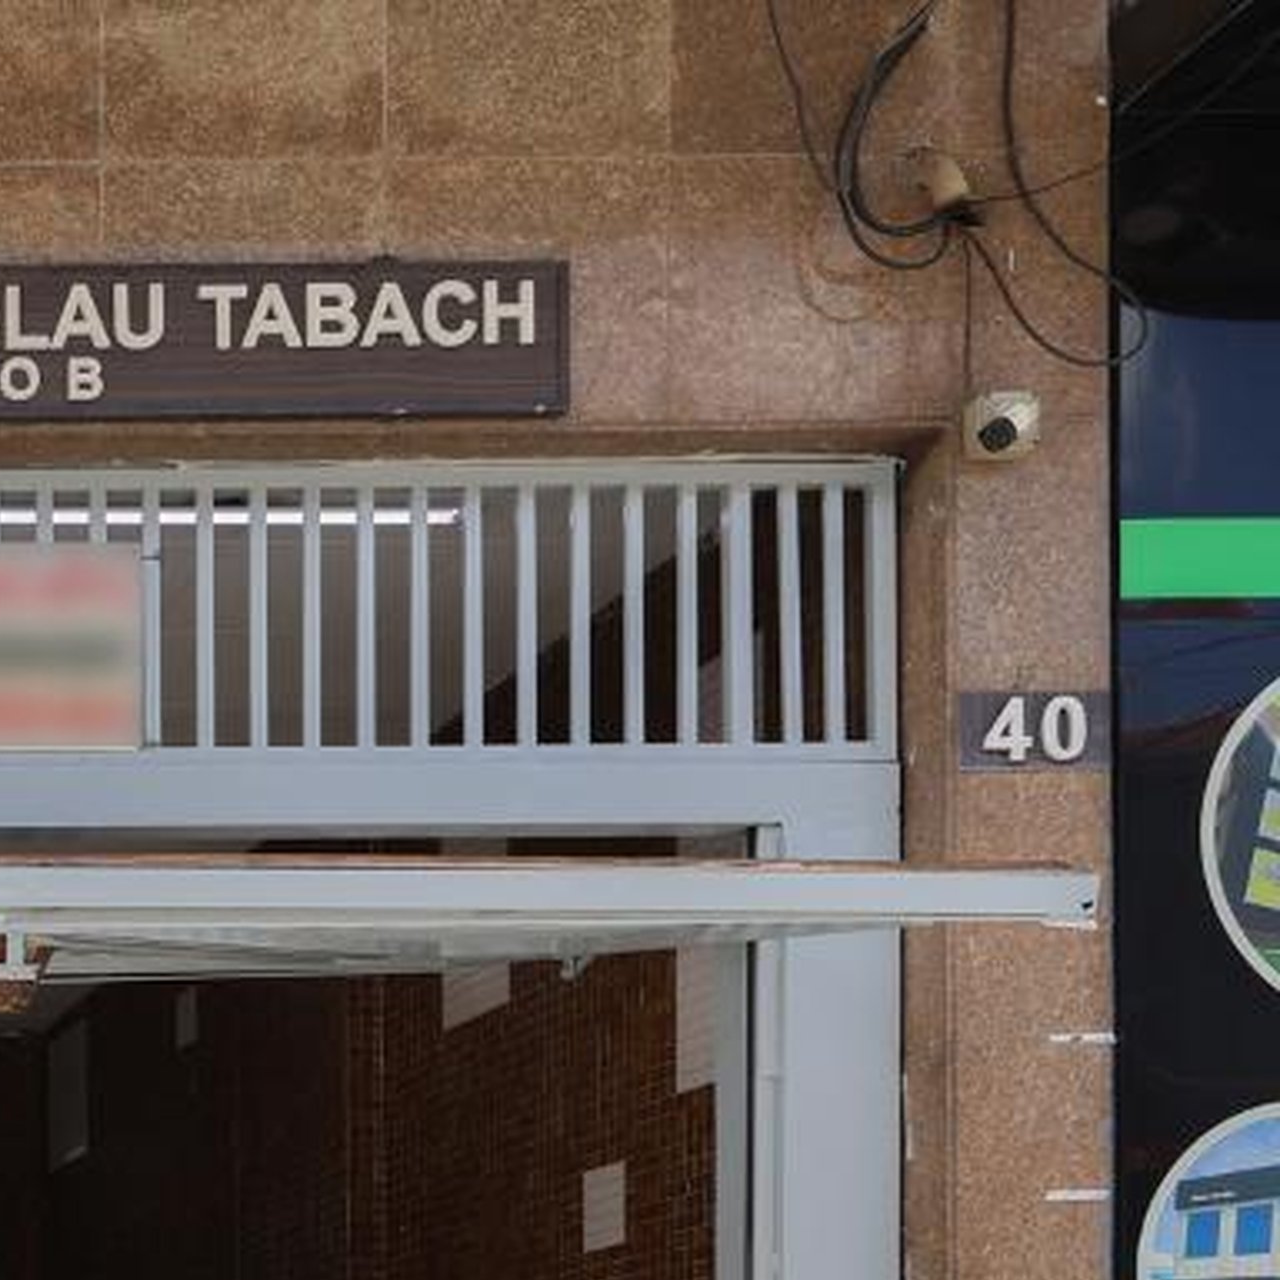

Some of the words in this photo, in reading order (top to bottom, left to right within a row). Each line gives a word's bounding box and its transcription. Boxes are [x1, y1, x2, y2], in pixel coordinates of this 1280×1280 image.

[197, 278, 536, 350] TABACH
[67, 356, 105, 401] B
[982, 696, 1089, 762] 40
